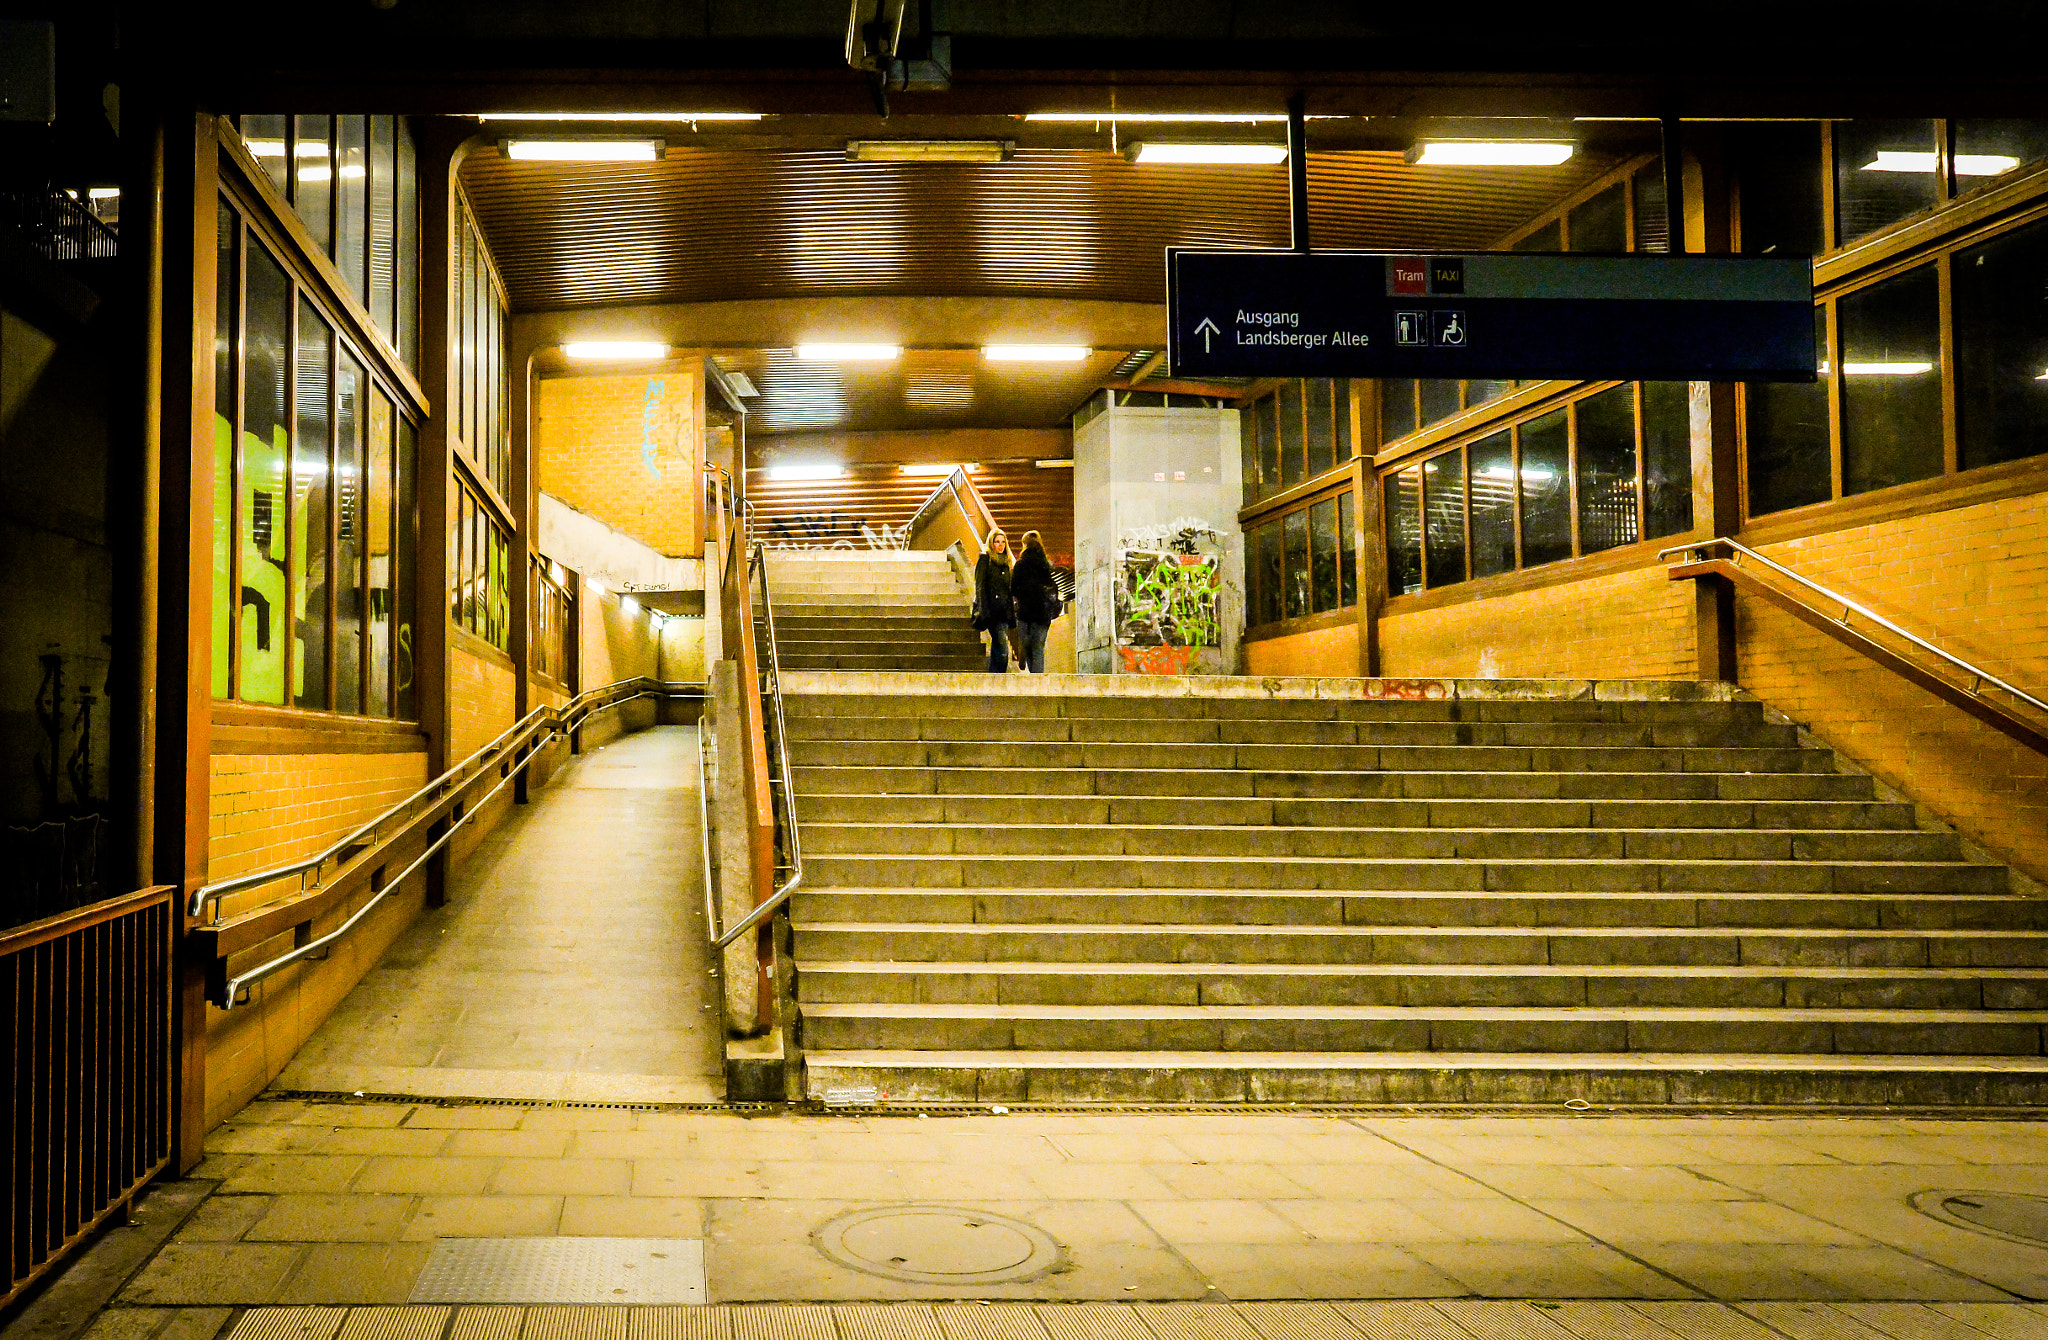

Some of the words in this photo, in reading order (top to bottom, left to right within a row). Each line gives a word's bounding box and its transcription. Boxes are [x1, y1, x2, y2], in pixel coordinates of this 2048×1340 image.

[1396, 269, 1424, 281] Tram
[1434, 269, 1460, 281] TAXI
[1235, 309, 1299, 327] Ausgang
[1236, 330, 1328, 349] Landsberger
[1331, 331, 1369, 346] Allee
